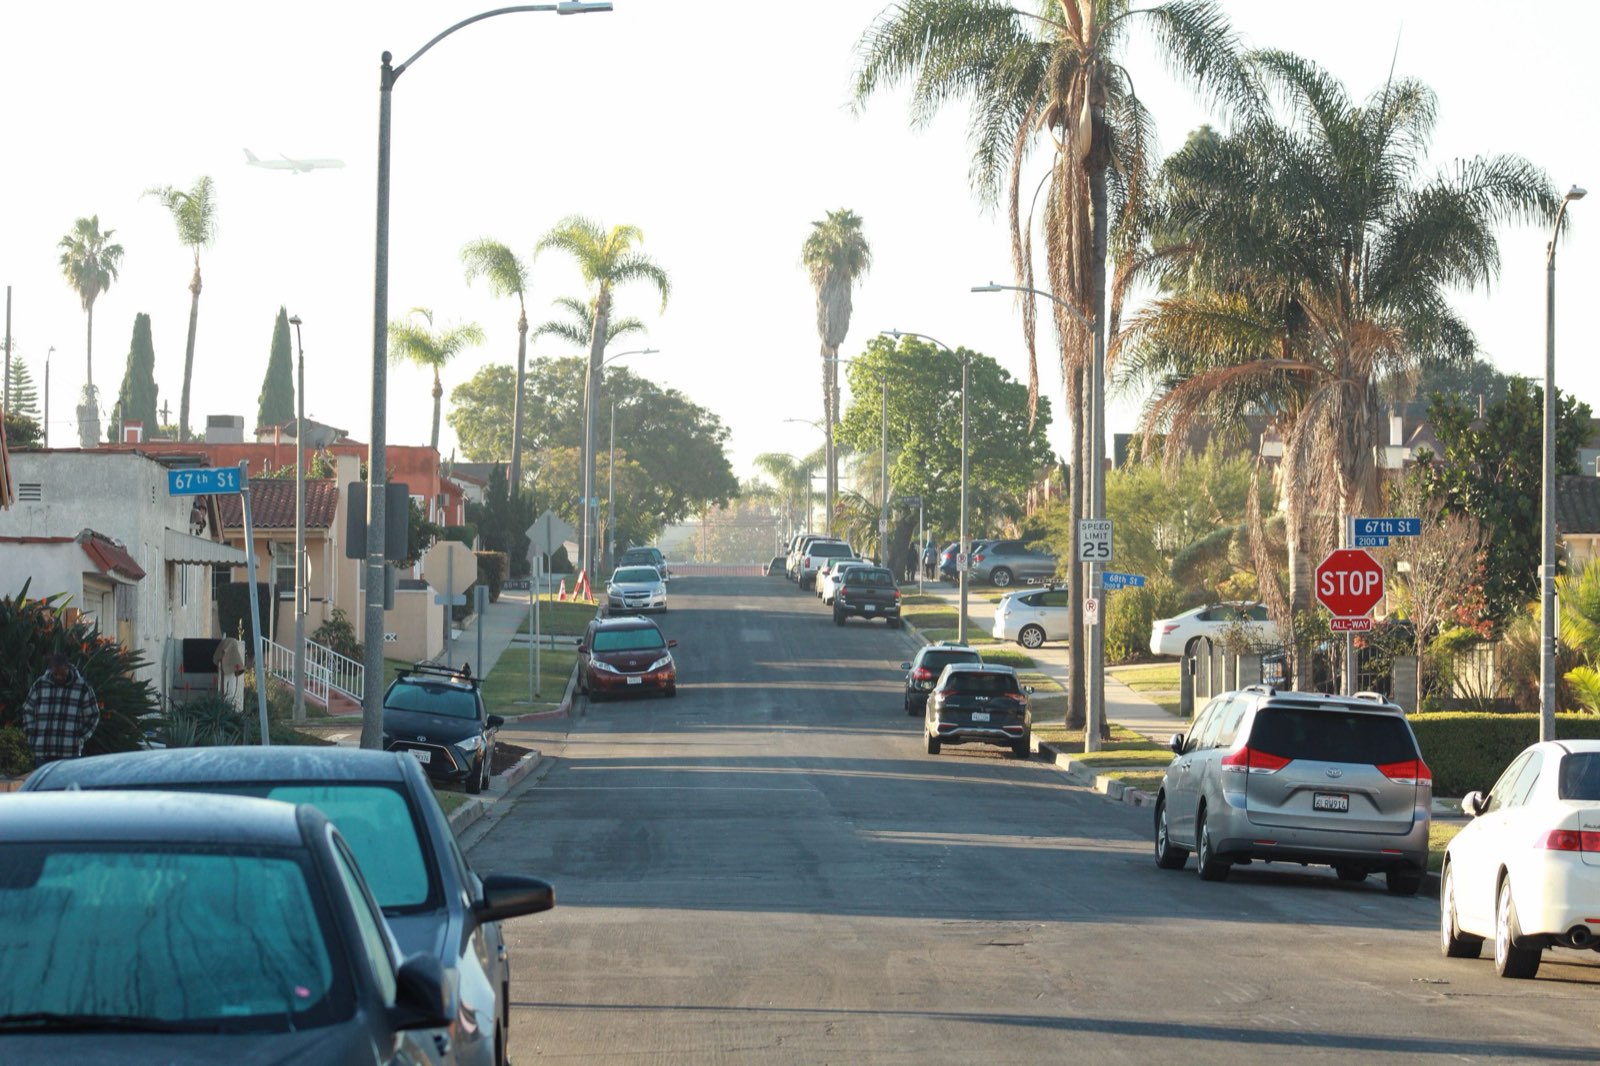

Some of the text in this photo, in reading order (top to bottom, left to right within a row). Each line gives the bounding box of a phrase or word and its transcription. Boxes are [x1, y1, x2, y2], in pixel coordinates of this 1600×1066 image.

[175, 472, 234, 490] 67th St
[1082, 523, 1110, 531] SPEED
[1365, 521, 1411, 533] 67th St
[1359, 537, 1385, 546] 2100 W
[1083, 542, 1109, 557] 25
[1109, 574, 1138, 585] 68th St
[1321, 570, 1379, 596] STOP
[1332, 620, 1369, 629] ALL-WAY
